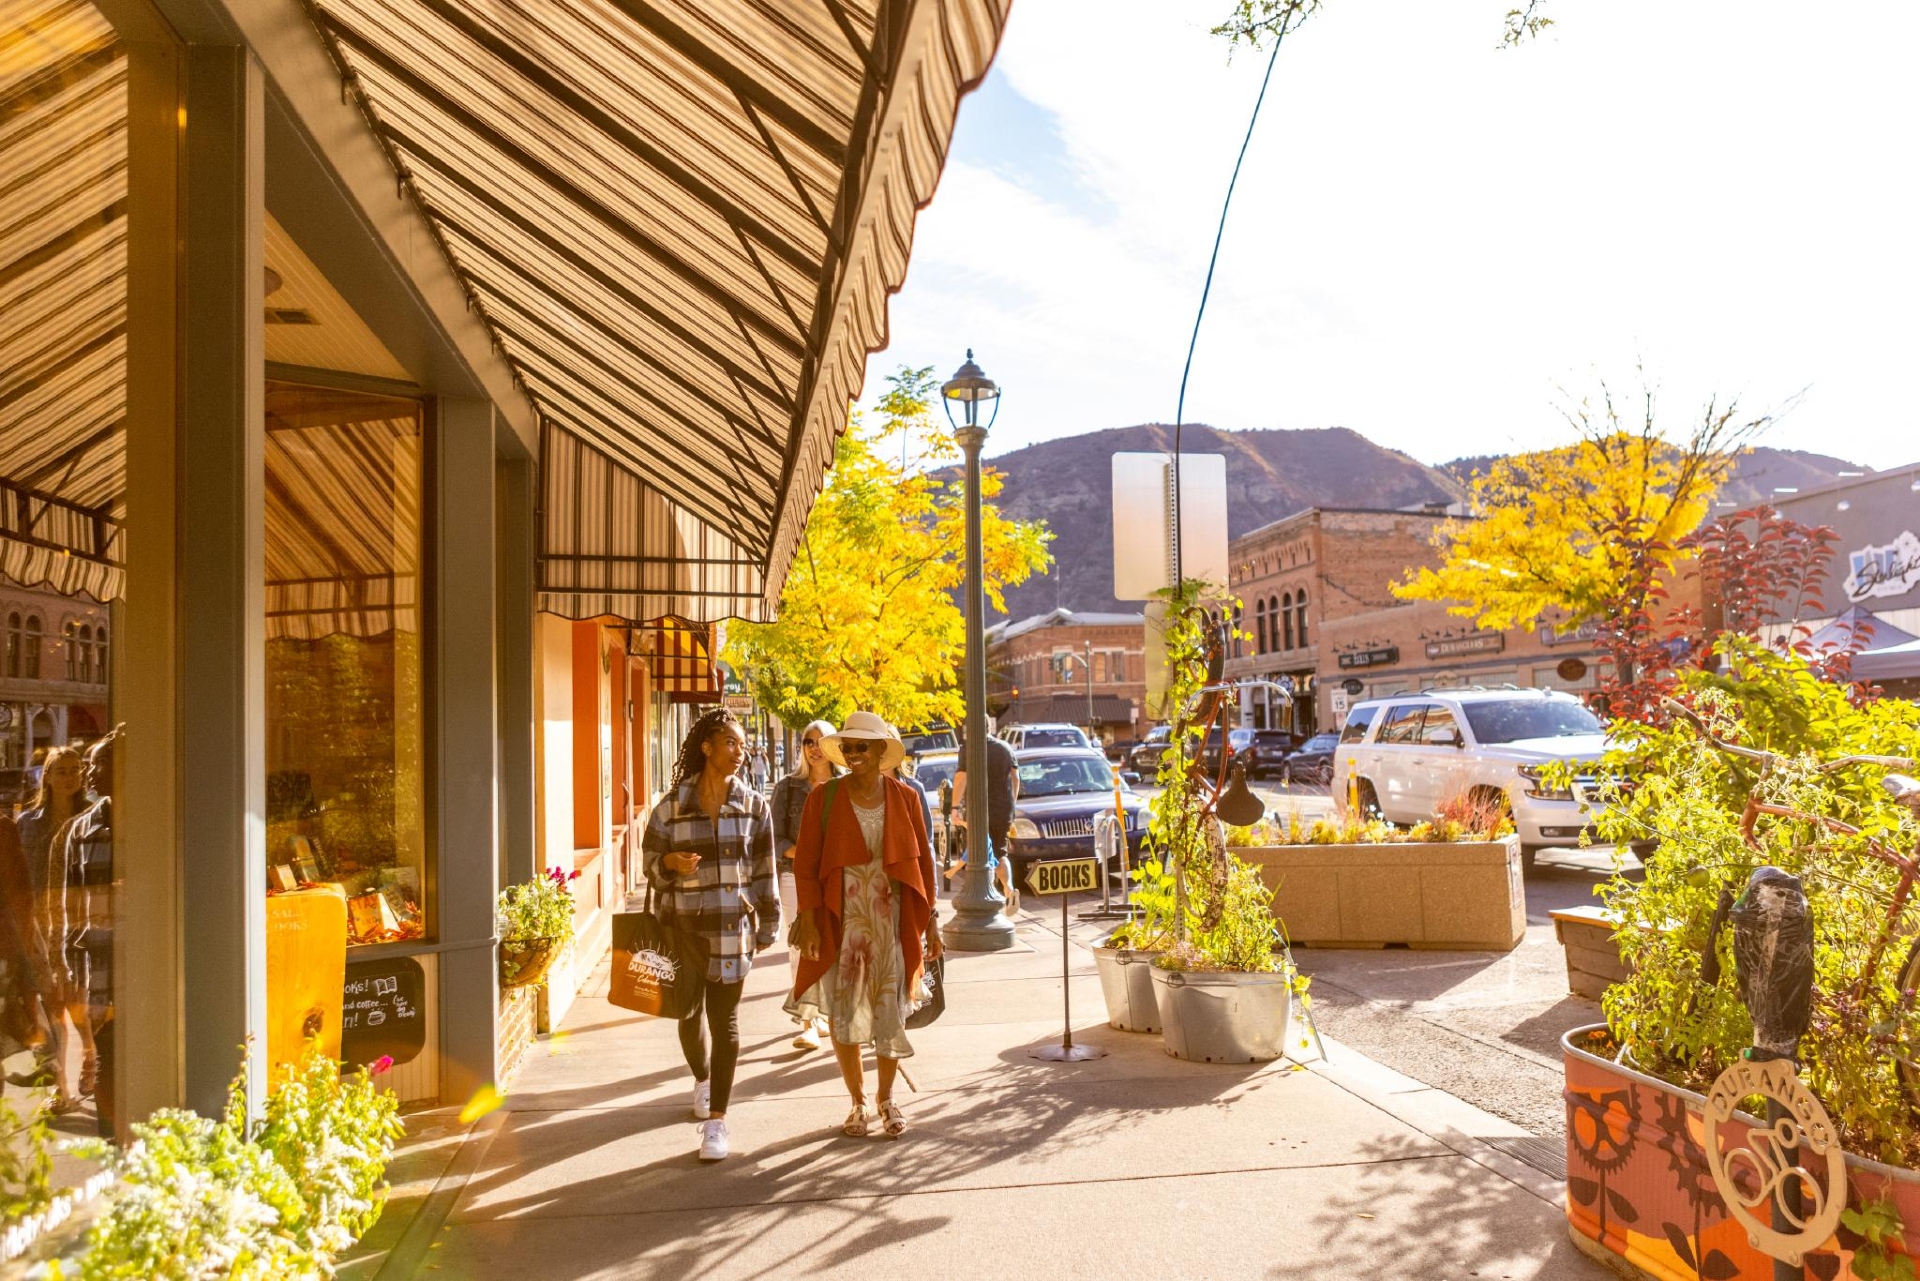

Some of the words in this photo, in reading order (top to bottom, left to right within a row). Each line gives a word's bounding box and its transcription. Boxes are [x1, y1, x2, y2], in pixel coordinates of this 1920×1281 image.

[1335, 701, 1345, 710] 15
[1039, 864, 1091, 891] BOOKS
[628, 962, 676, 982] DURANGO
[344, 979, 369, 995] oks!
[343, 1012, 358, 1028] n!
[1712, 1067, 1829, 1145] DURANGO
